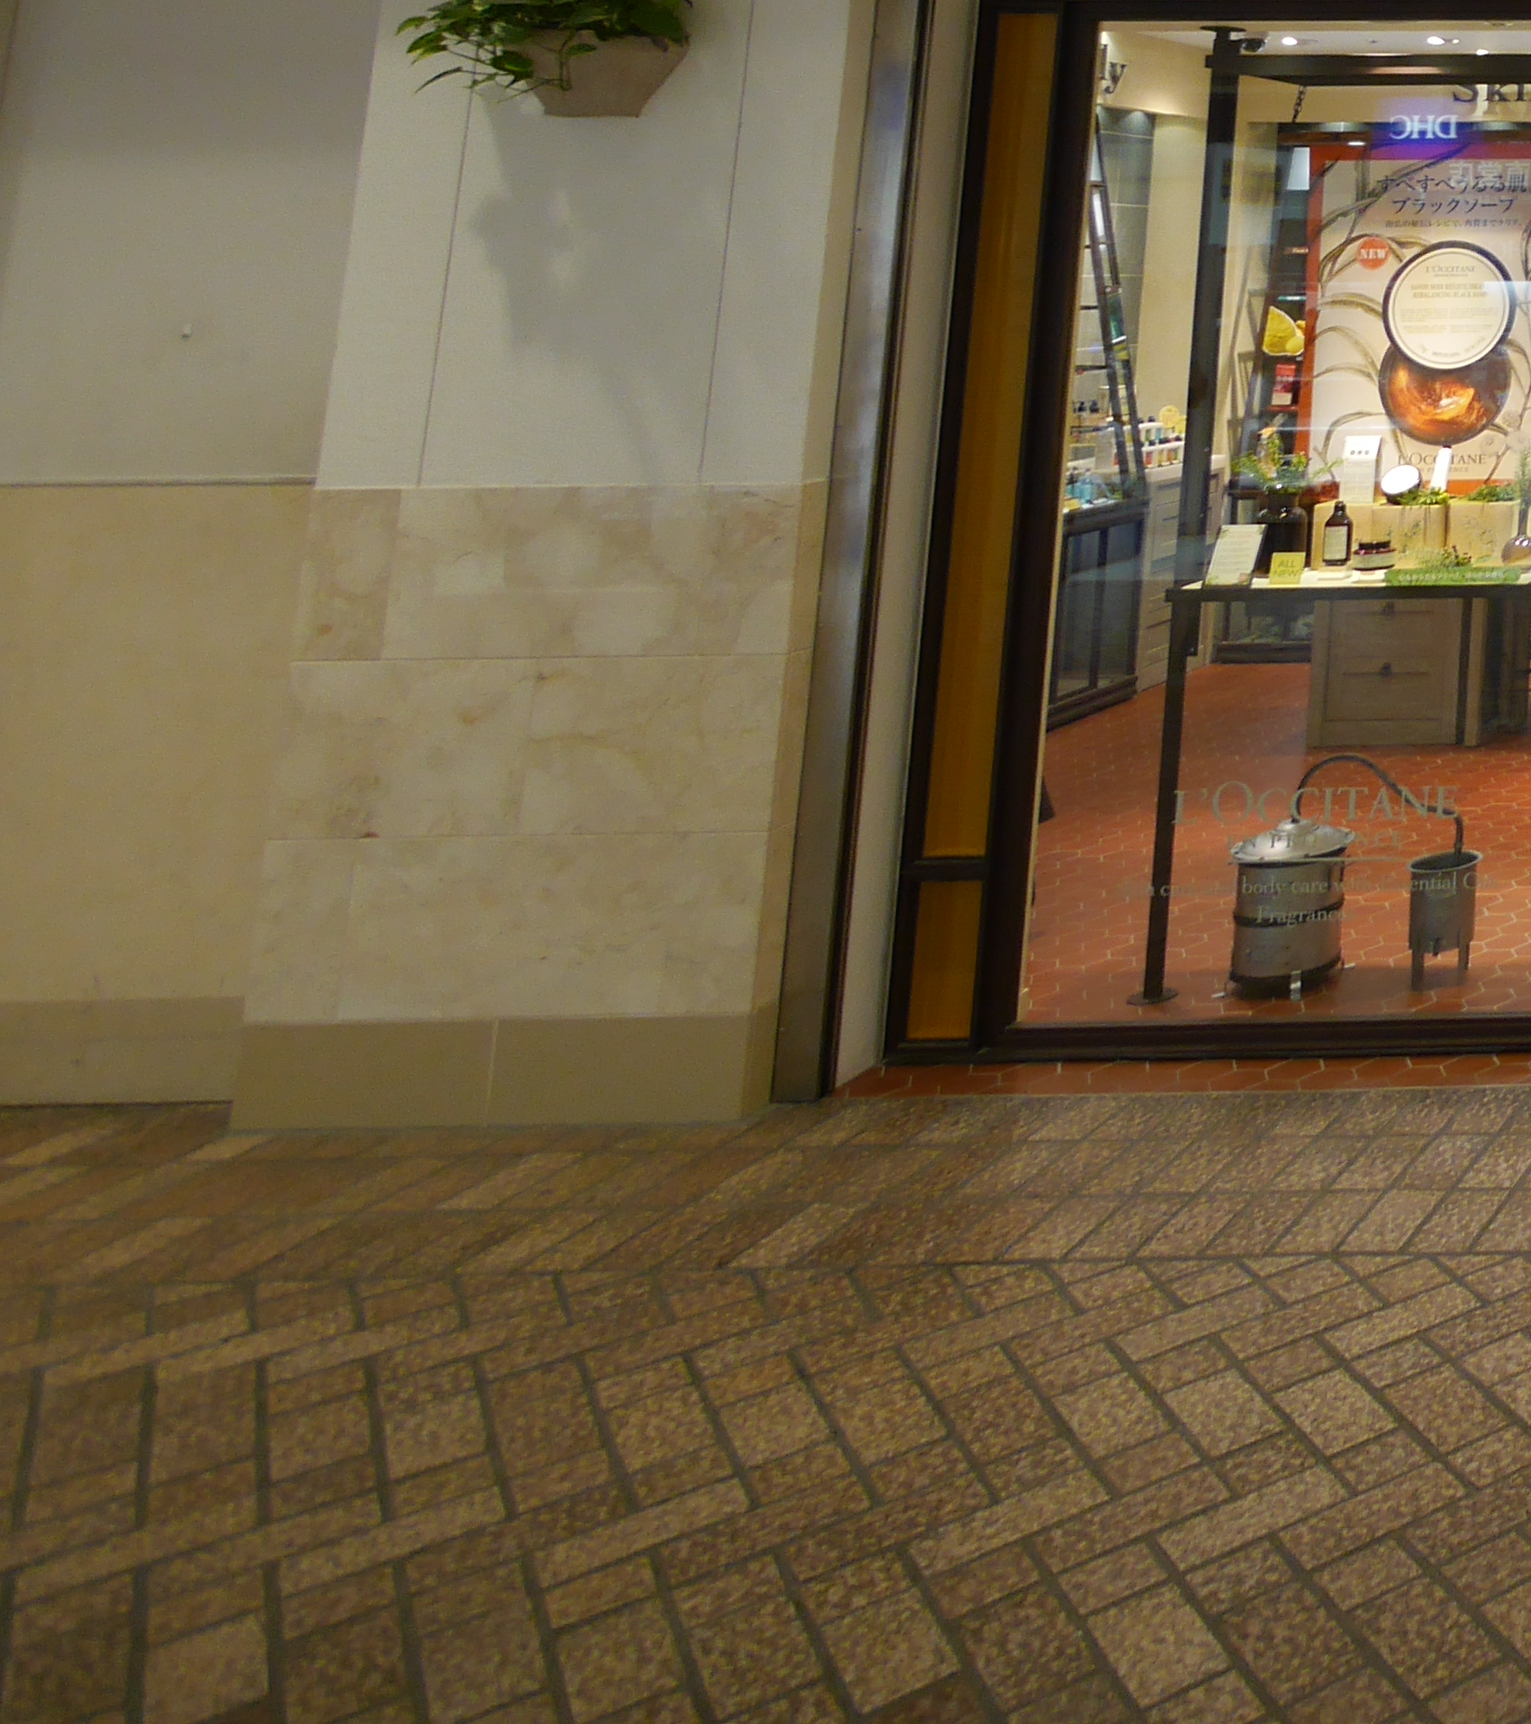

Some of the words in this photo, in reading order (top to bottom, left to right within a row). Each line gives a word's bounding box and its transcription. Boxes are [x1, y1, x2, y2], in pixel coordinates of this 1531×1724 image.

[1392, 197, 1519, 215] ブラックソープ
[1358, 247, 1388, 260] NEW
[1171, 780, 1459, 825] L'OCCITANE
